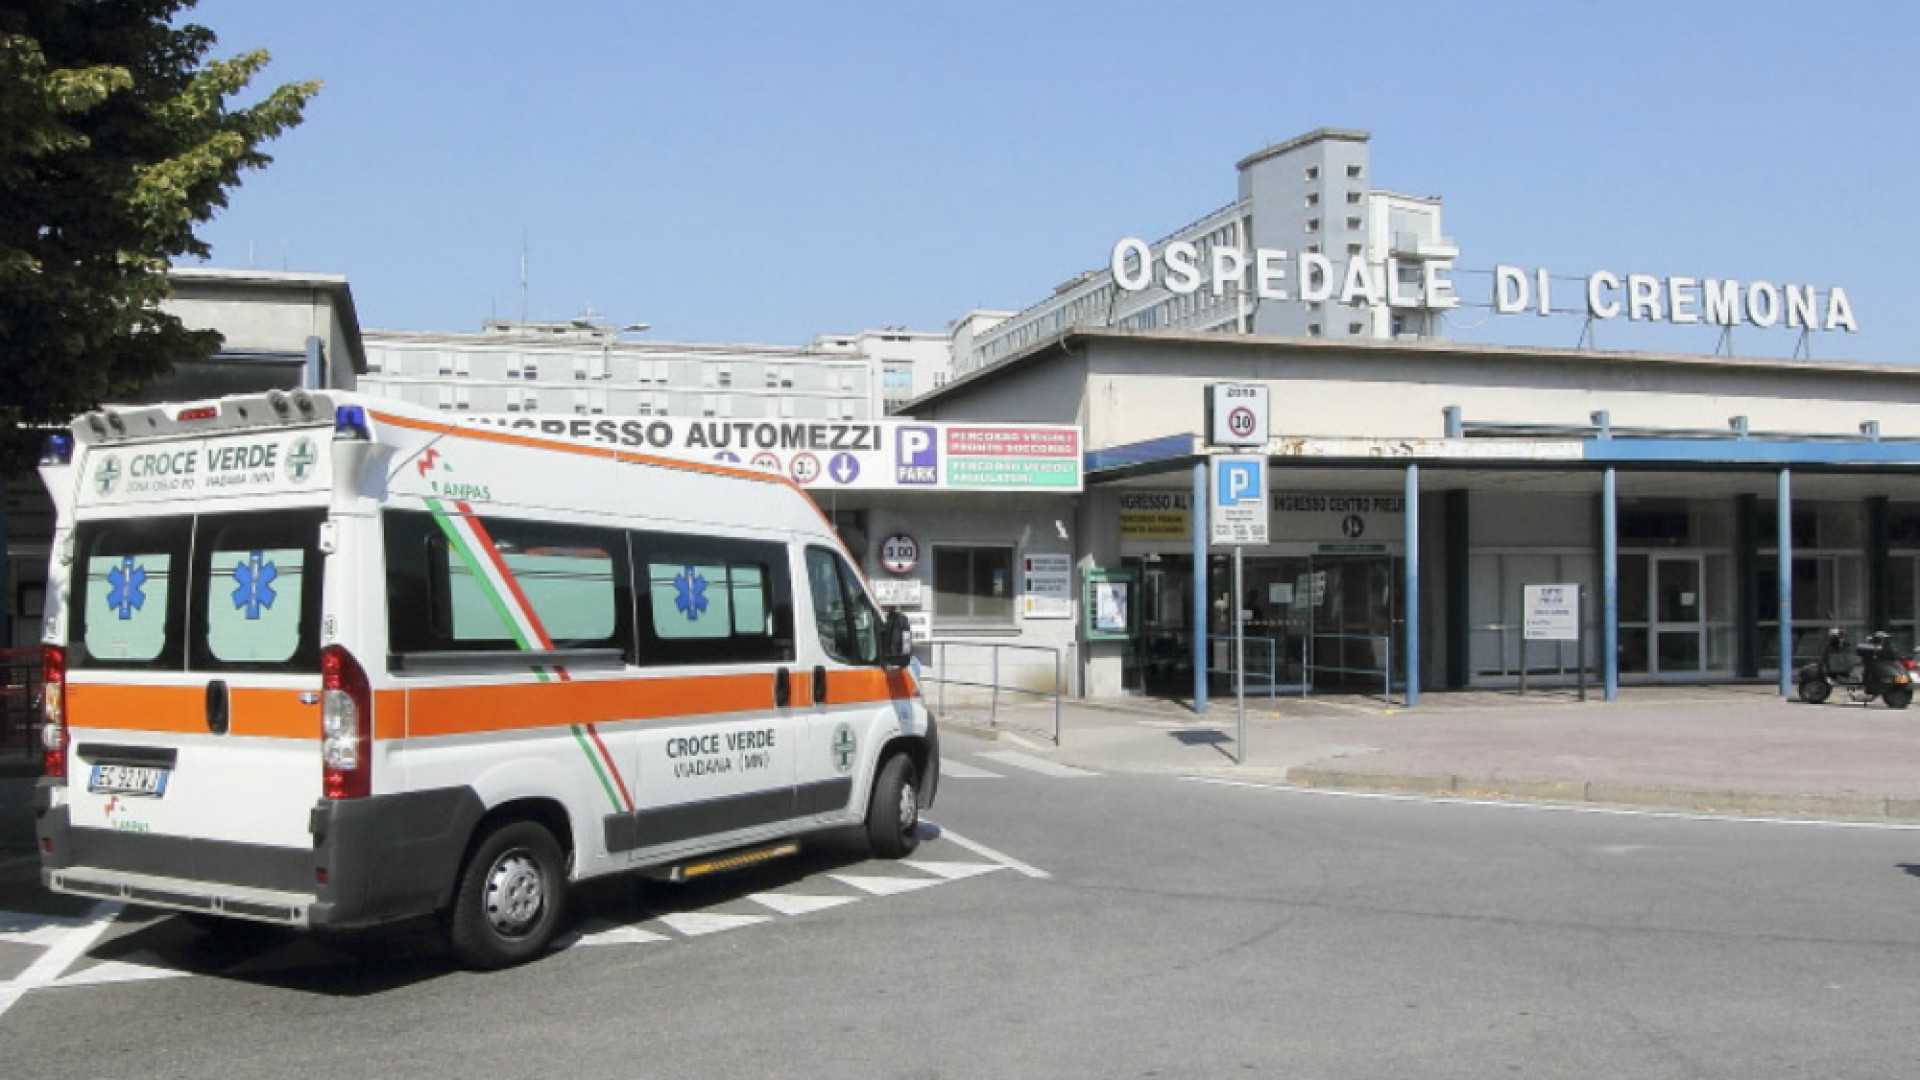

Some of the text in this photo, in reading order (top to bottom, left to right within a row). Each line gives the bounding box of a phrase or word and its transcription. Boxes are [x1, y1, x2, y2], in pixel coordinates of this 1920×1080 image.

[1111, 236, 1858, 333] OSPEDALE DI CREMONA
[685, 422, 881, 451] AUTOMEZZI
[901, 430, 930, 465] P
[130, 443, 278, 477] CROCE VERDE
[899, 467, 936, 482] PARK
[1230, 467, 1249, 500] P
[667, 729, 775, 758] CROCE VERDE
